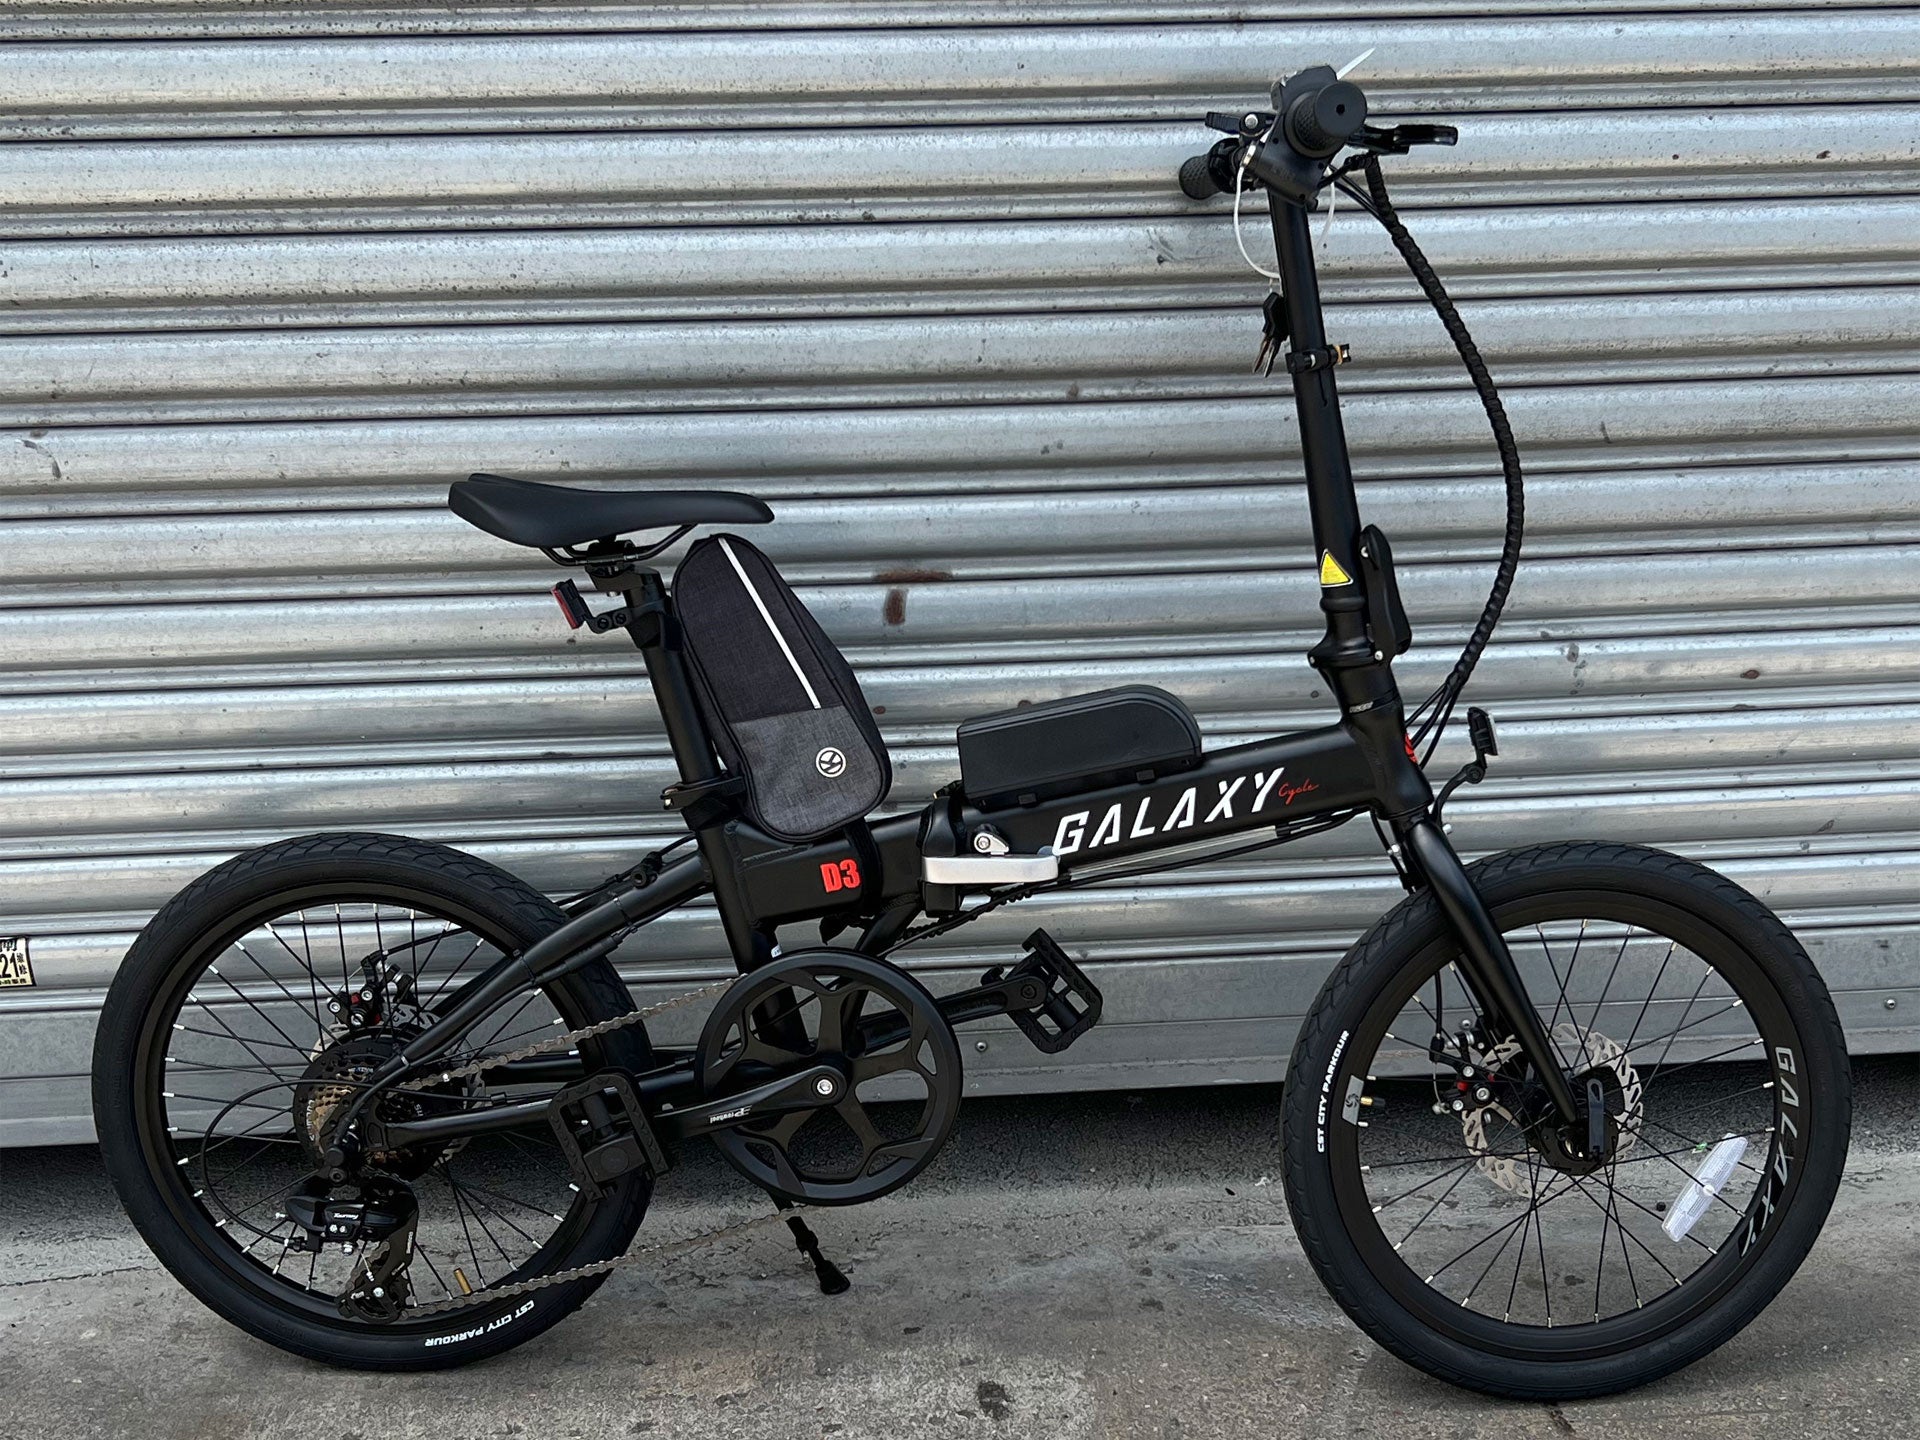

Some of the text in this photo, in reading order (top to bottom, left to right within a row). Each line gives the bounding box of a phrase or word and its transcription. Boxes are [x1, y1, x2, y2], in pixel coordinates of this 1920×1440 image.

[1052, 767, 1285, 856] GALAXY
[820, 859, 861, 893] D3
[1317, 1030, 1349, 1153] CST CITY PARKOUR
[1741, 1046, 1799, 1258] GALAXY
[424, 1300, 535, 1347] CST CITY PARKOUR
